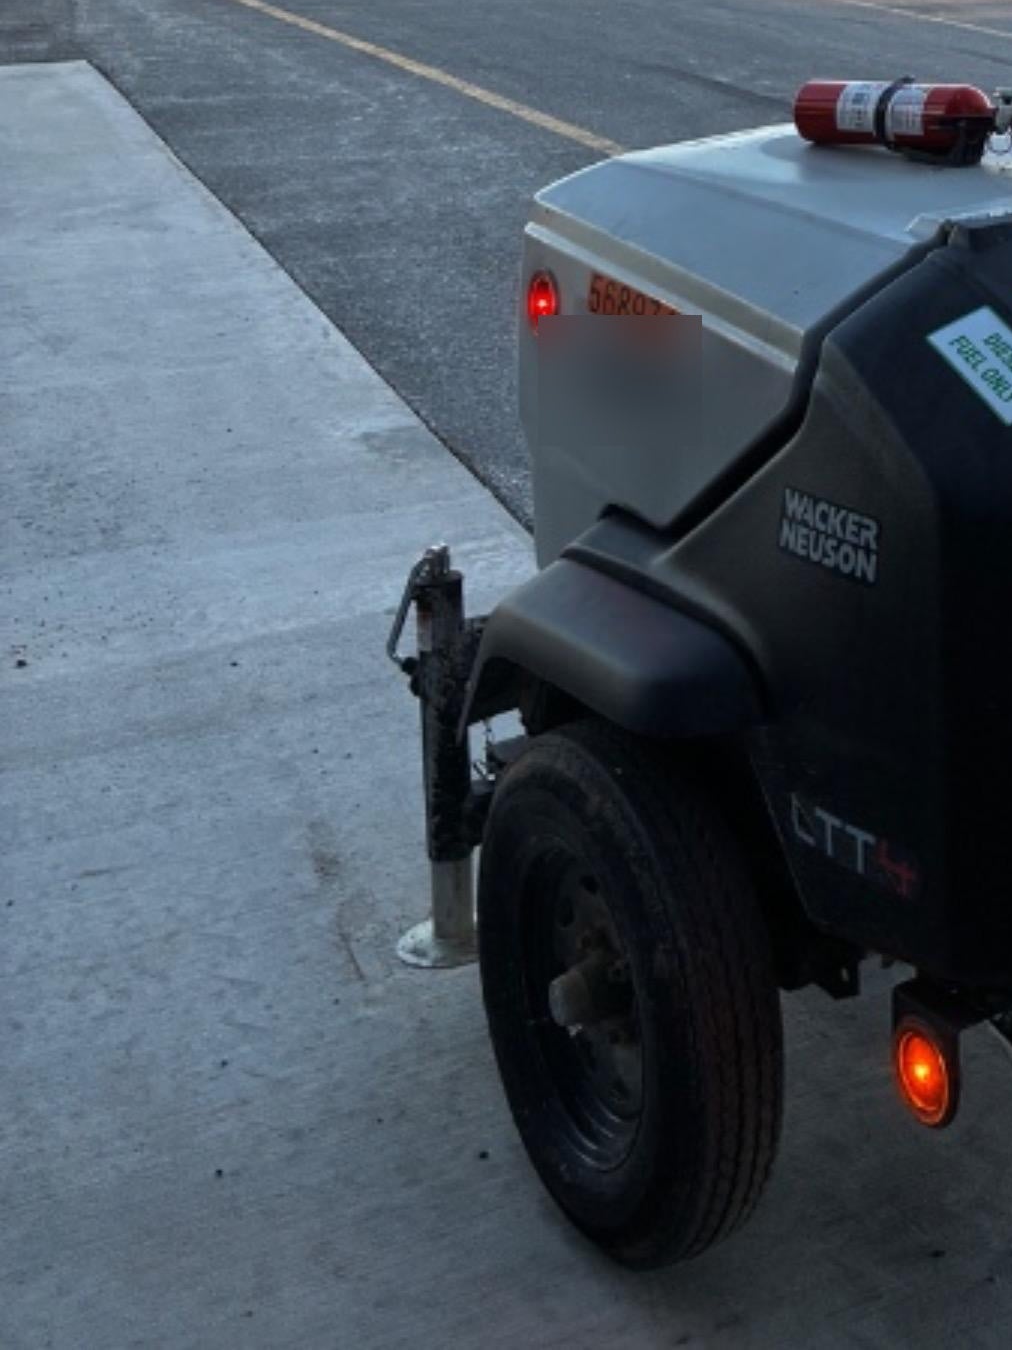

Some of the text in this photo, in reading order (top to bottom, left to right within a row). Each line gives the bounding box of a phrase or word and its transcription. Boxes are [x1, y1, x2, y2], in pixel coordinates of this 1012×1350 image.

[948, 335, 988, 371] FUEL
[780, 518, 877, 583] NEUSON
[785, 488, 878, 551] WACKER
